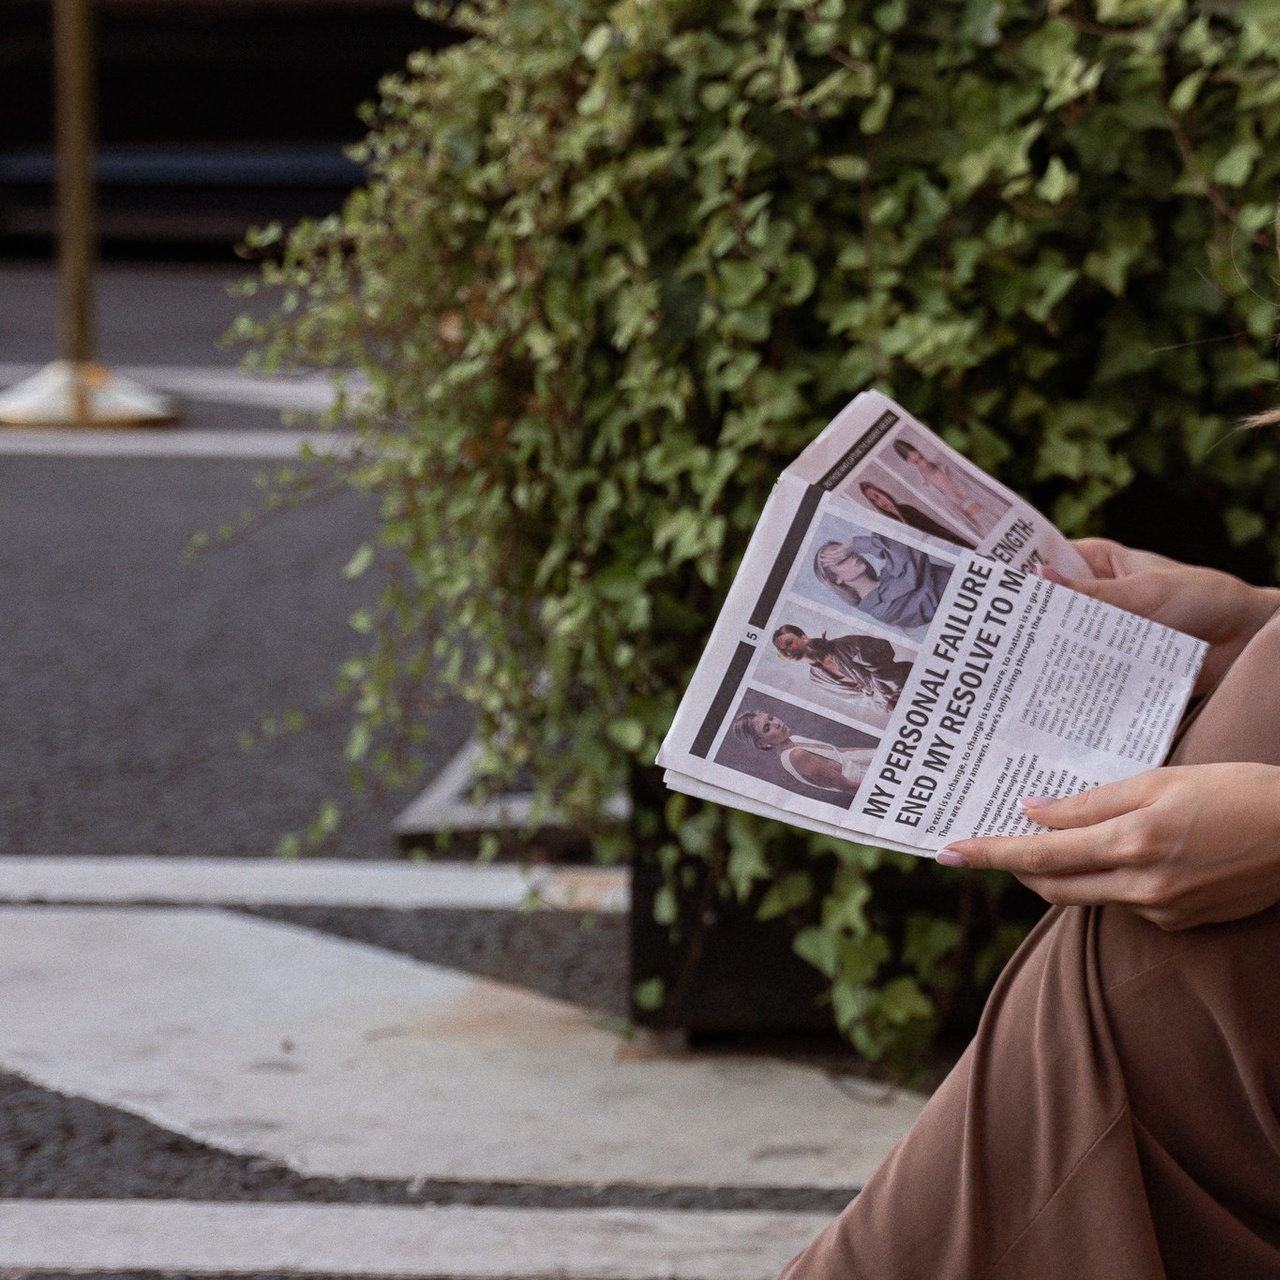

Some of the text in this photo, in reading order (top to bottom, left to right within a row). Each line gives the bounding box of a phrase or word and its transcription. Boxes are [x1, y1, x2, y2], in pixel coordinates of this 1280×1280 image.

[998, 568, 1027, 594] M
[983, 596, 1014, 627] TO
[1031, 615, 1042, 630] the
[746, 632, 758, 641] 5
[1015, 631, 1035, 667] through
[862, 561, 992, 819] MY PERSONAL FAILURE
[939, 628, 1001, 734] RESOLVE
[1003, 668, 1022, 693] living
[925, 825, 936, 834] To
[932, 807, 945, 825] exist
[943, 791, 952, 800] to
[948, 762, 967, 792] change,
[961, 751, 971, 761] to
[966, 720, 984, 751] change
[978, 712, 988, 720] is
[983, 702, 992, 711] to
[988, 669, 1007, 701] mature,
[1002, 657, 1011, 666] to
[1007, 623, 1025, 656] mature
[1019, 615, 1028, 623] is
[1024, 604, 1032, 614] to
[1029, 592, 1038, 604] go
[997, 693, 1011, 713] only
[922, 733, 955, 773] MY
[970, 743, 990, 777] answers,
[1020, 754, 1039, 784] interpret
[961, 777, 975, 795] easy
[973, 806, 991, 831] forward
[990, 784, 1001, 800] your
[997, 771, 1008, 784] day
[1003, 757, 1013, 771] and
[984, 824, 994, 832] let
[990, 798, 1007, 824] negative
[1002, 768, 1021, 798] thoughts
[1017, 753, 1026, 768] con-
[1016, 785, 1025, 797] you
[1050, 789, 1060, 799] he
[895, 775, 938, 828] ENED
[950, 805, 961, 818] are
[956, 795, 965, 805] no
[937, 818, 954, 837] There
[996, 811, 1013, 833] Change
